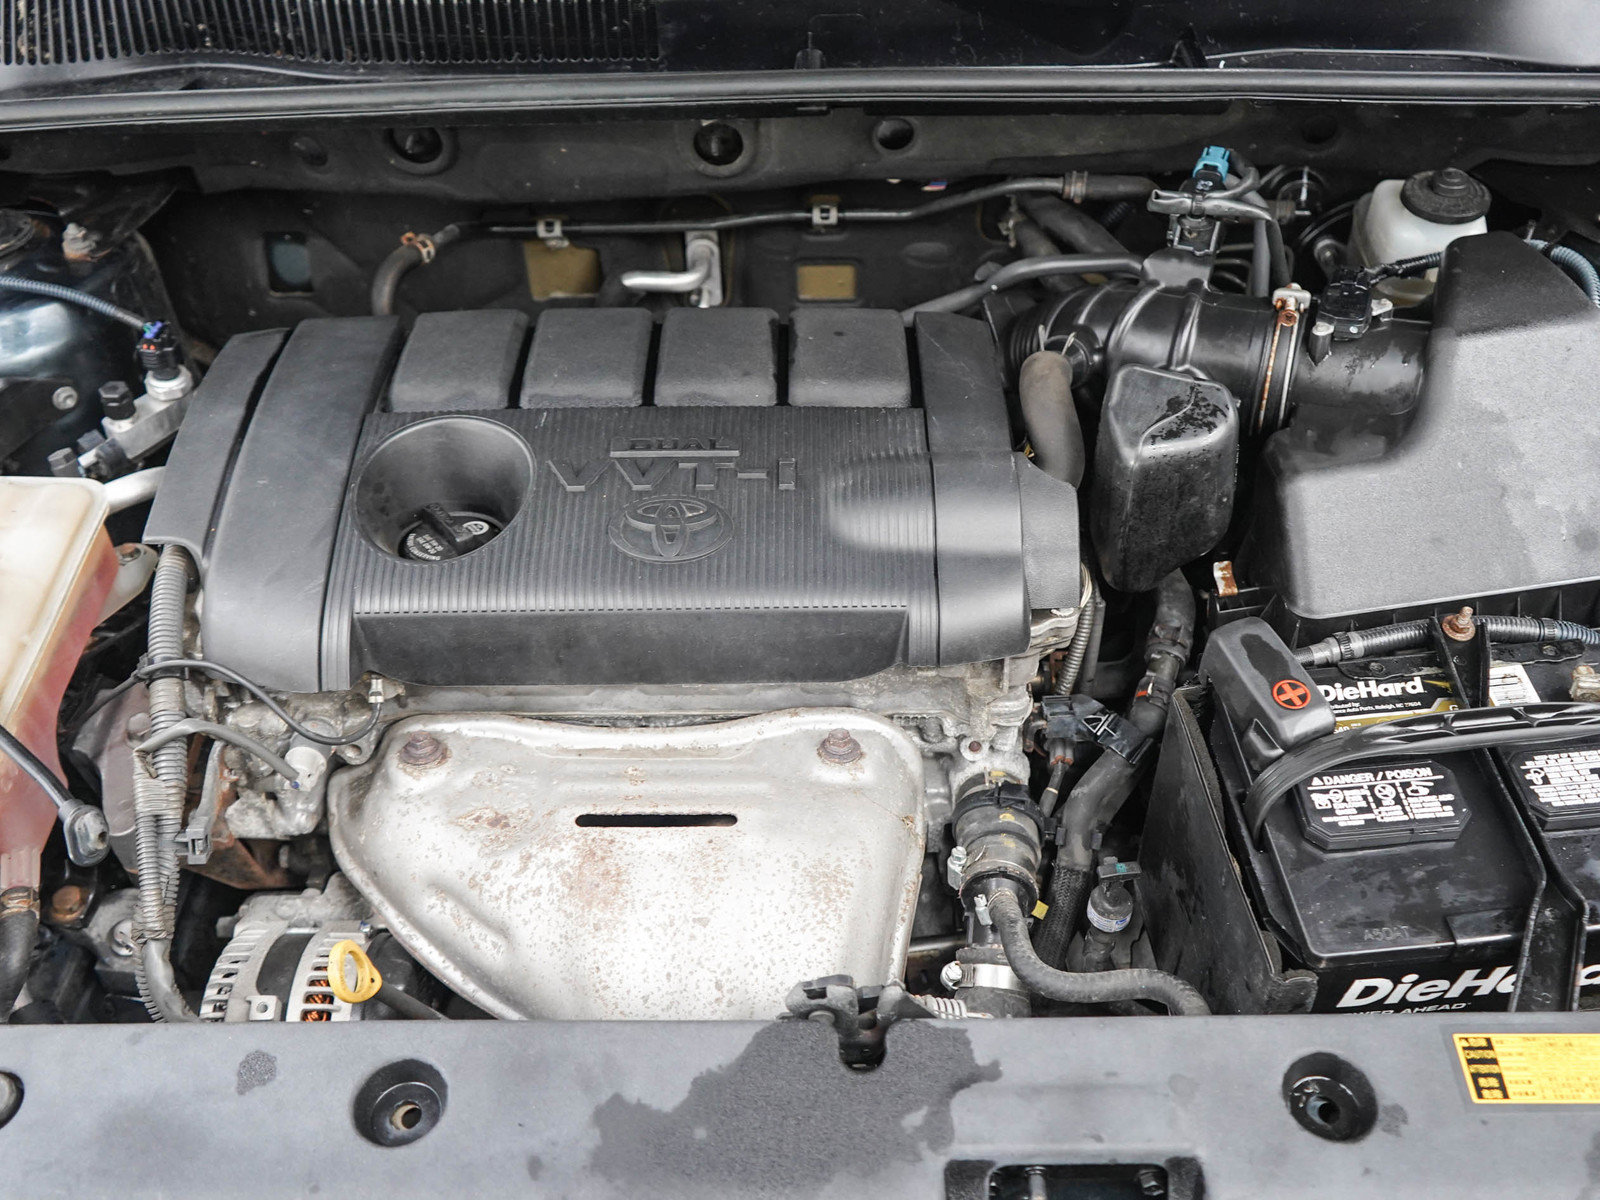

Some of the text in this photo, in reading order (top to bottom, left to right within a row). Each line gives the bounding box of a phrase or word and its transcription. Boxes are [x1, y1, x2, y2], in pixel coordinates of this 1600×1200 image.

[1317, 676, 1424, 701] DieHard
[1322, 772, 1375, 785] DANGER
[1386, 767, 1433, 780] POISON
